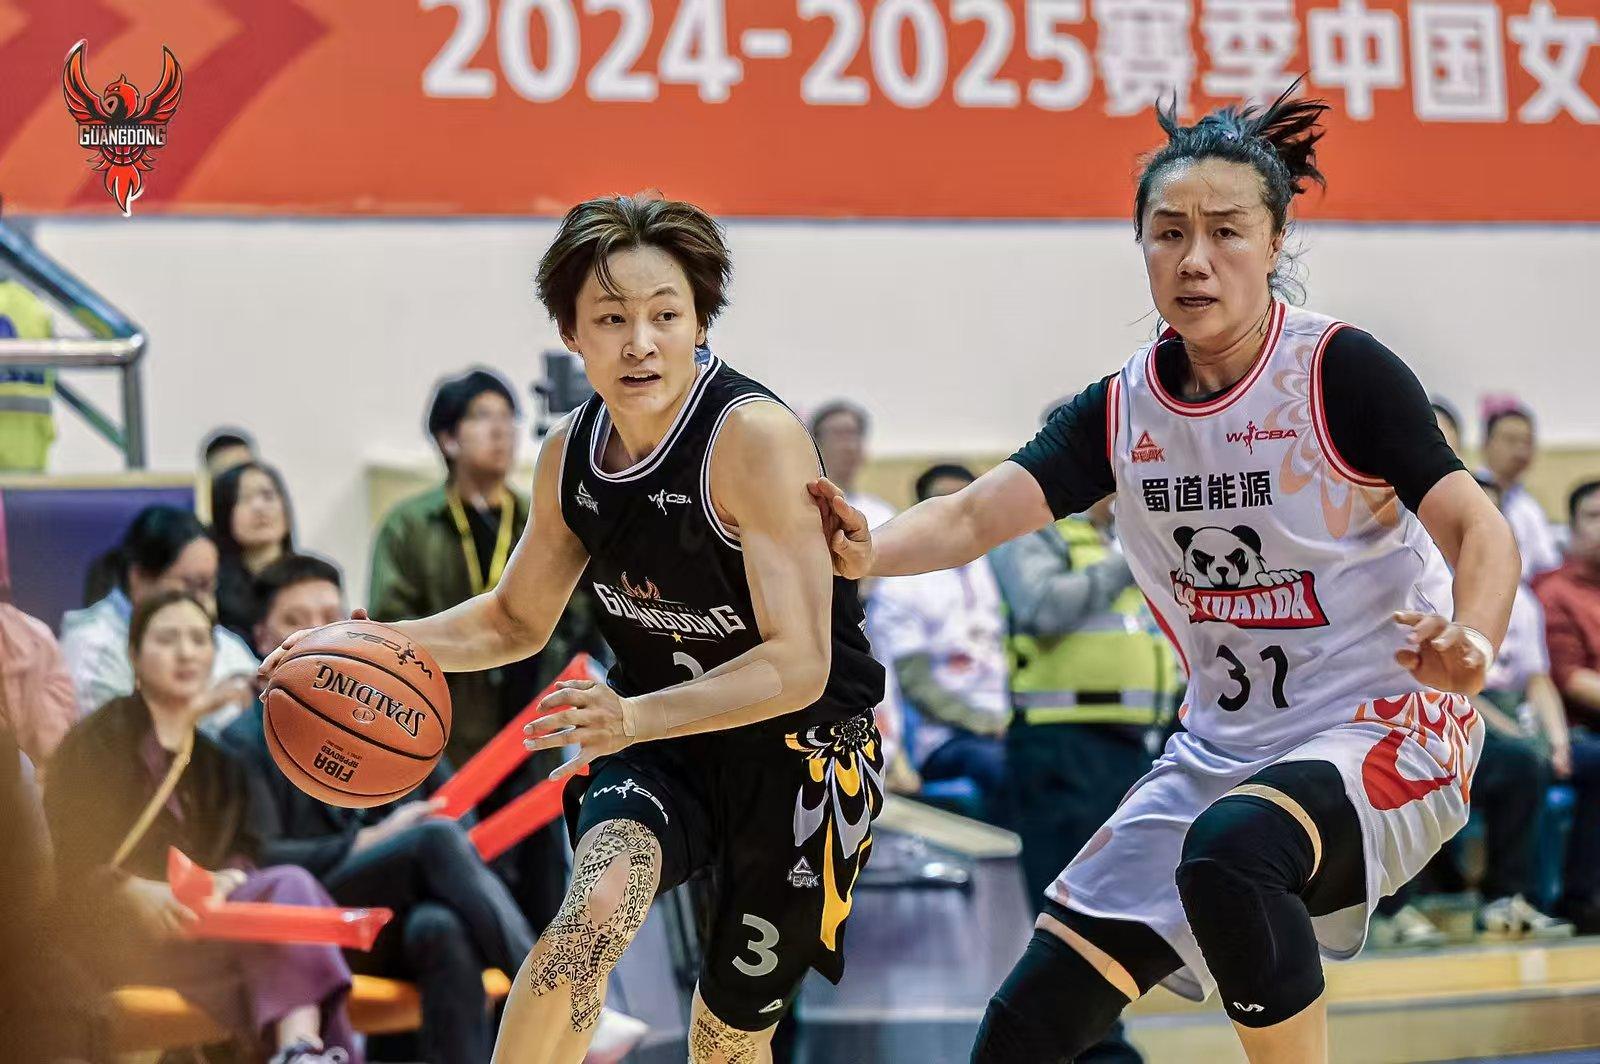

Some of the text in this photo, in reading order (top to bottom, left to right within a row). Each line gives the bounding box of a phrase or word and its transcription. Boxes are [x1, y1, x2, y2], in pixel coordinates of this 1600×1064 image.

[1142, 470, 1273, 512] 蜀道能源
[312, 663, 427, 739] SPALDING
[1215, 644, 1289, 711] 31
[313, 752, 355, 782] FIBA
[321, 745, 360, 768] APPROVED
[732, 913, 780, 976] 3
